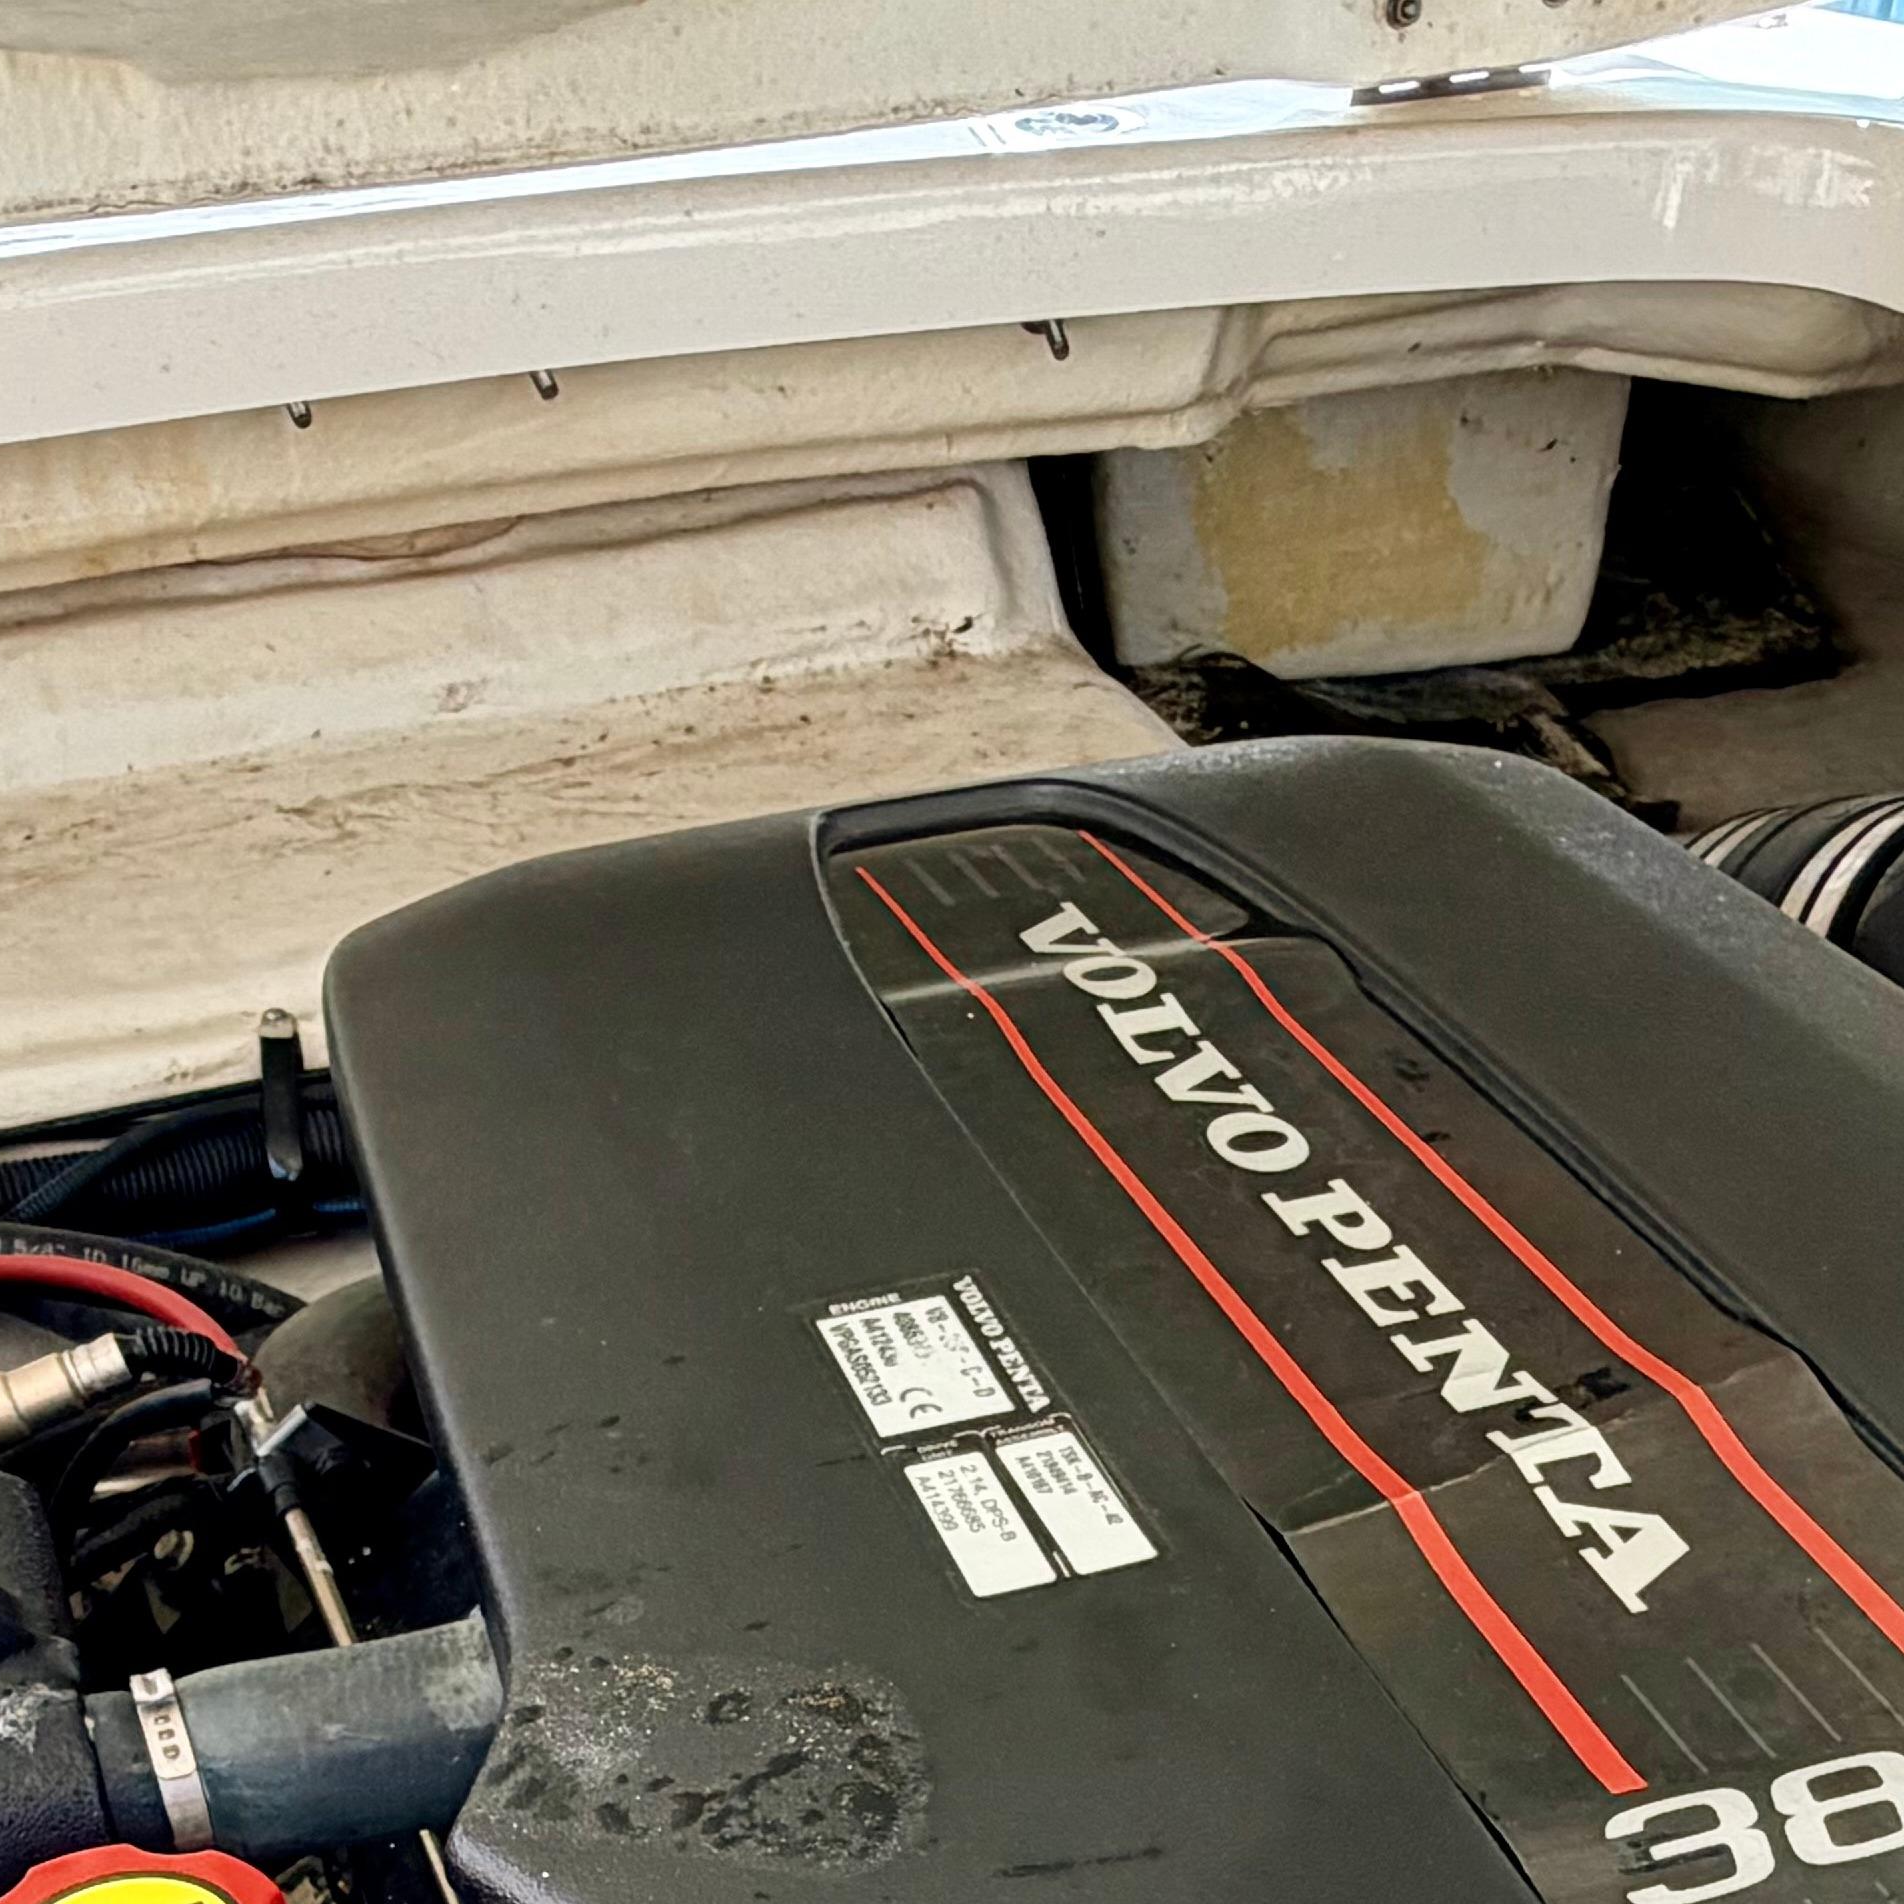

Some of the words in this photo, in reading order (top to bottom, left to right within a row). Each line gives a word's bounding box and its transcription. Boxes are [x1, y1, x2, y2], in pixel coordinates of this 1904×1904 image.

[828, 1293, 901, 1315] ENGINE
[1019, 901, 1312, 1174] VOLVO
[1262, 1177, 1691, 1616] PENTA
[953, 1276, 1004, 1338] VOLVO
[989, 1337, 1050, 1413] PENTA
[981, 1498, 1017, 1543] DPS-B
